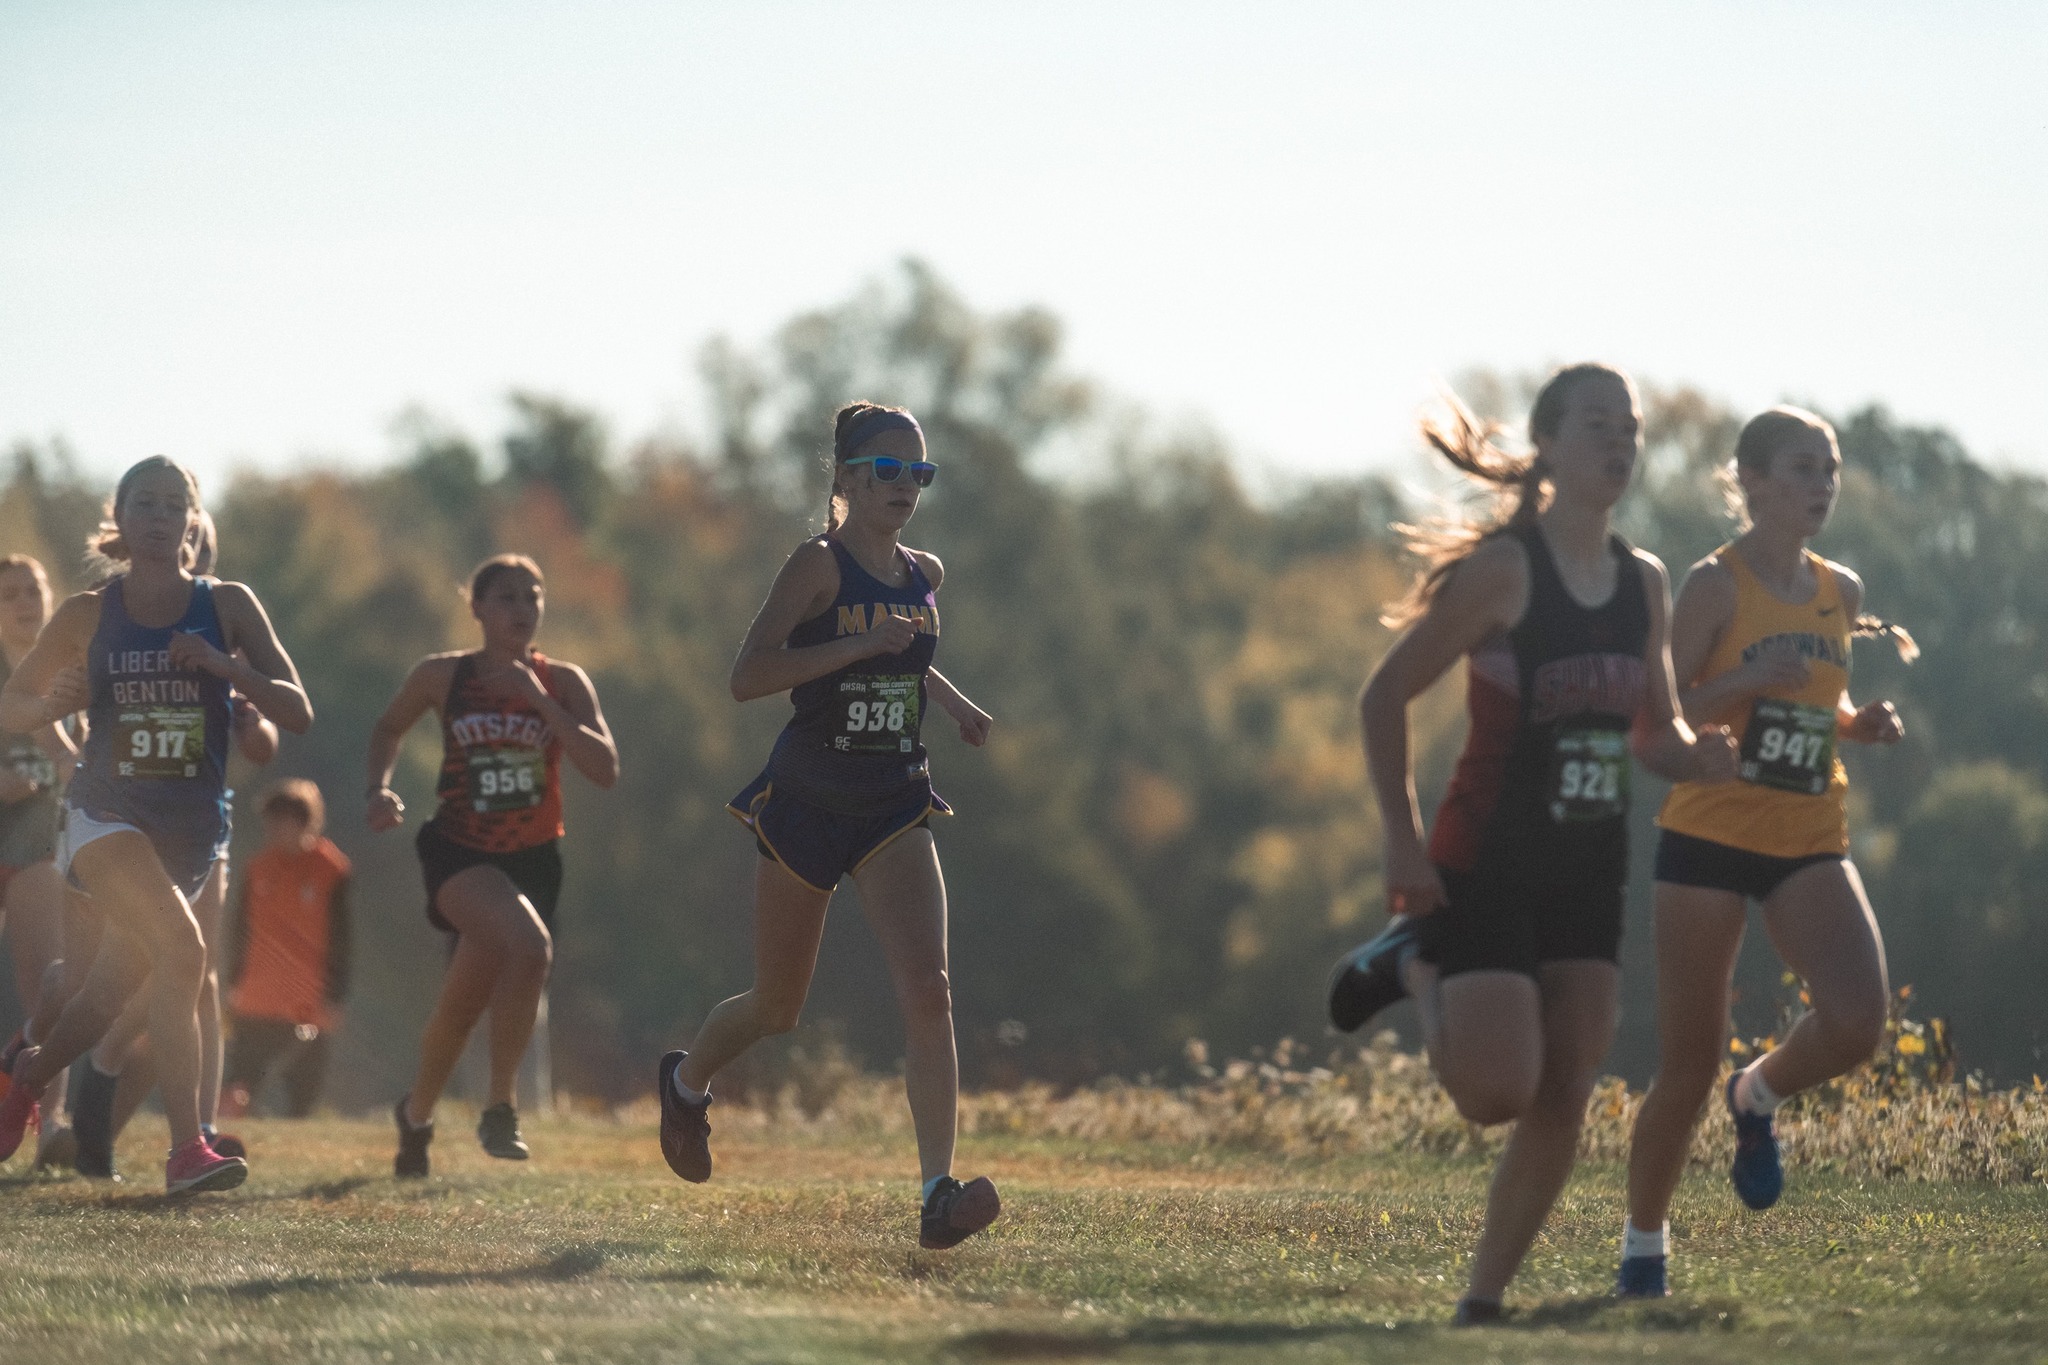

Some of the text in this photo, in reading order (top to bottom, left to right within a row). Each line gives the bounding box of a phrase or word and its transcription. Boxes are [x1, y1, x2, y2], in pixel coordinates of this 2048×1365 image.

[108, 650, 199, 675] LIBER
[113, 680, 200, 704] BENTON
[846, 701, 905, 731] 938
[131, 729, 187, 758] 917
[1757, 727, 1824, 769] 947
[479, 767, 534, 796] 956
